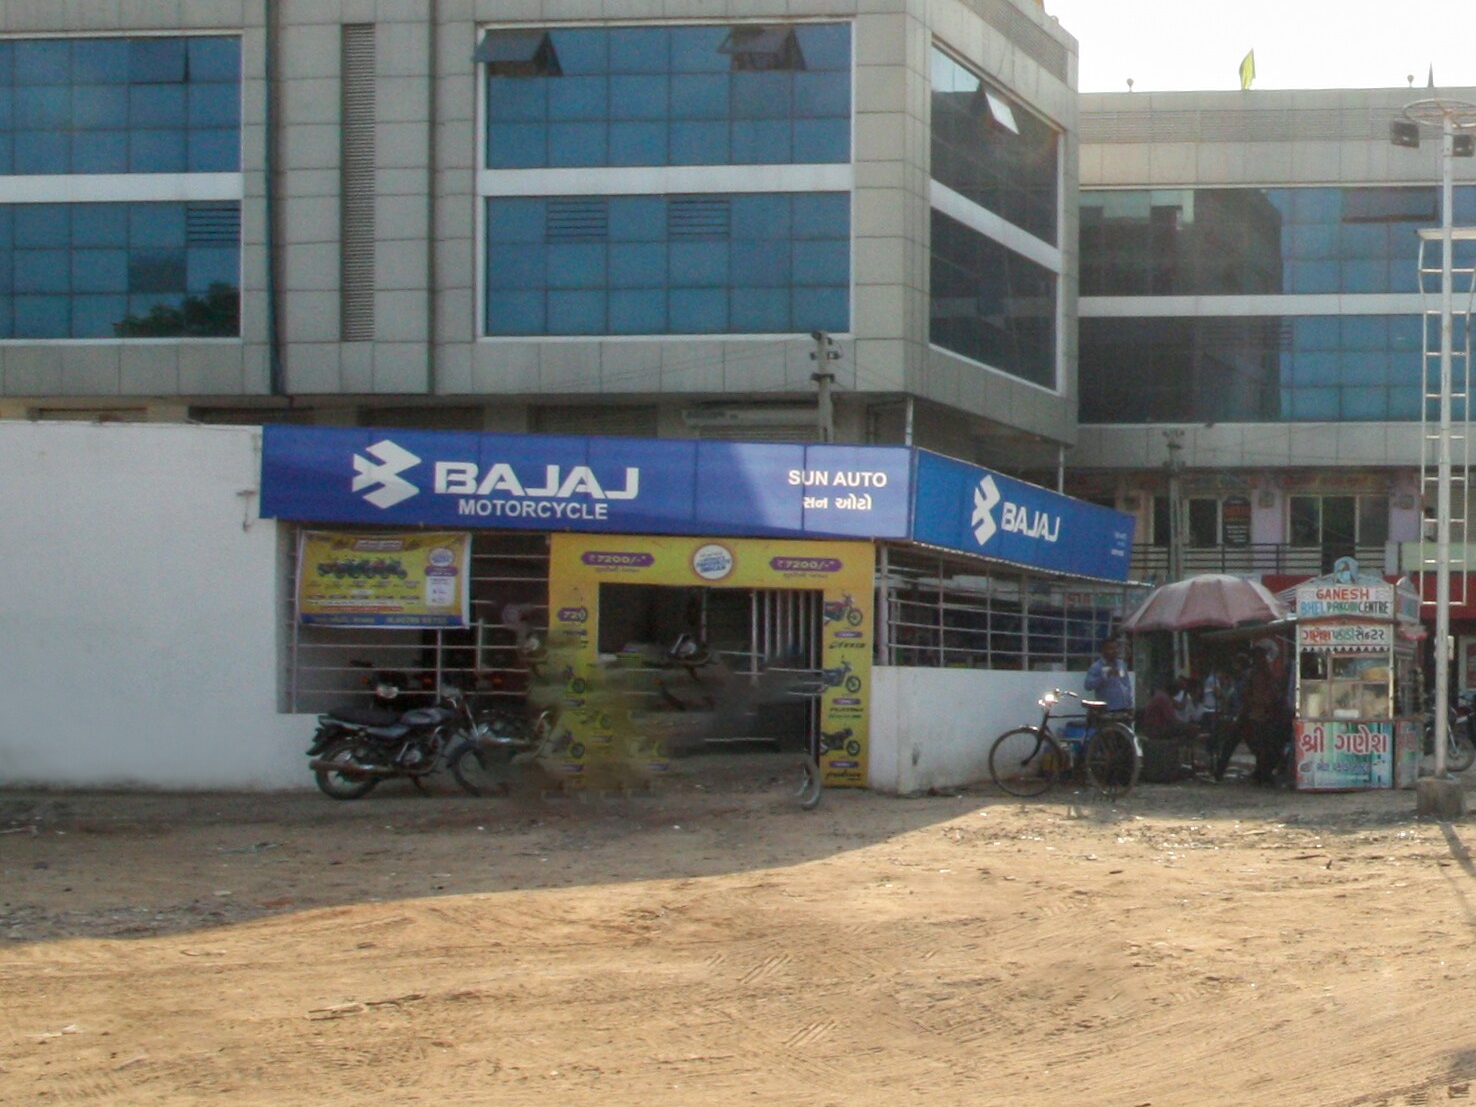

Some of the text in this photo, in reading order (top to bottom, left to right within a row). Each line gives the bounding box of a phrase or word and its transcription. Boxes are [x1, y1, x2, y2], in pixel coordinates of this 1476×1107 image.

[434, 461, 640, 500] BAJAJ
[788, 469, 887, 488] SUN AUTO
[458, 498, 609, 520] MOTORCYCLE
[803, 492, 872, 510] સન ઓટો
[1001, 501, 1061, 543] BAJAJ
[1315, 588, 1369, 600] GANESH
[1358, 601, 1389, 614] CENTRE
[1300, 725, 1325, 753] શ્રી
[1333, 725, 1389, 754] ગણેશ
